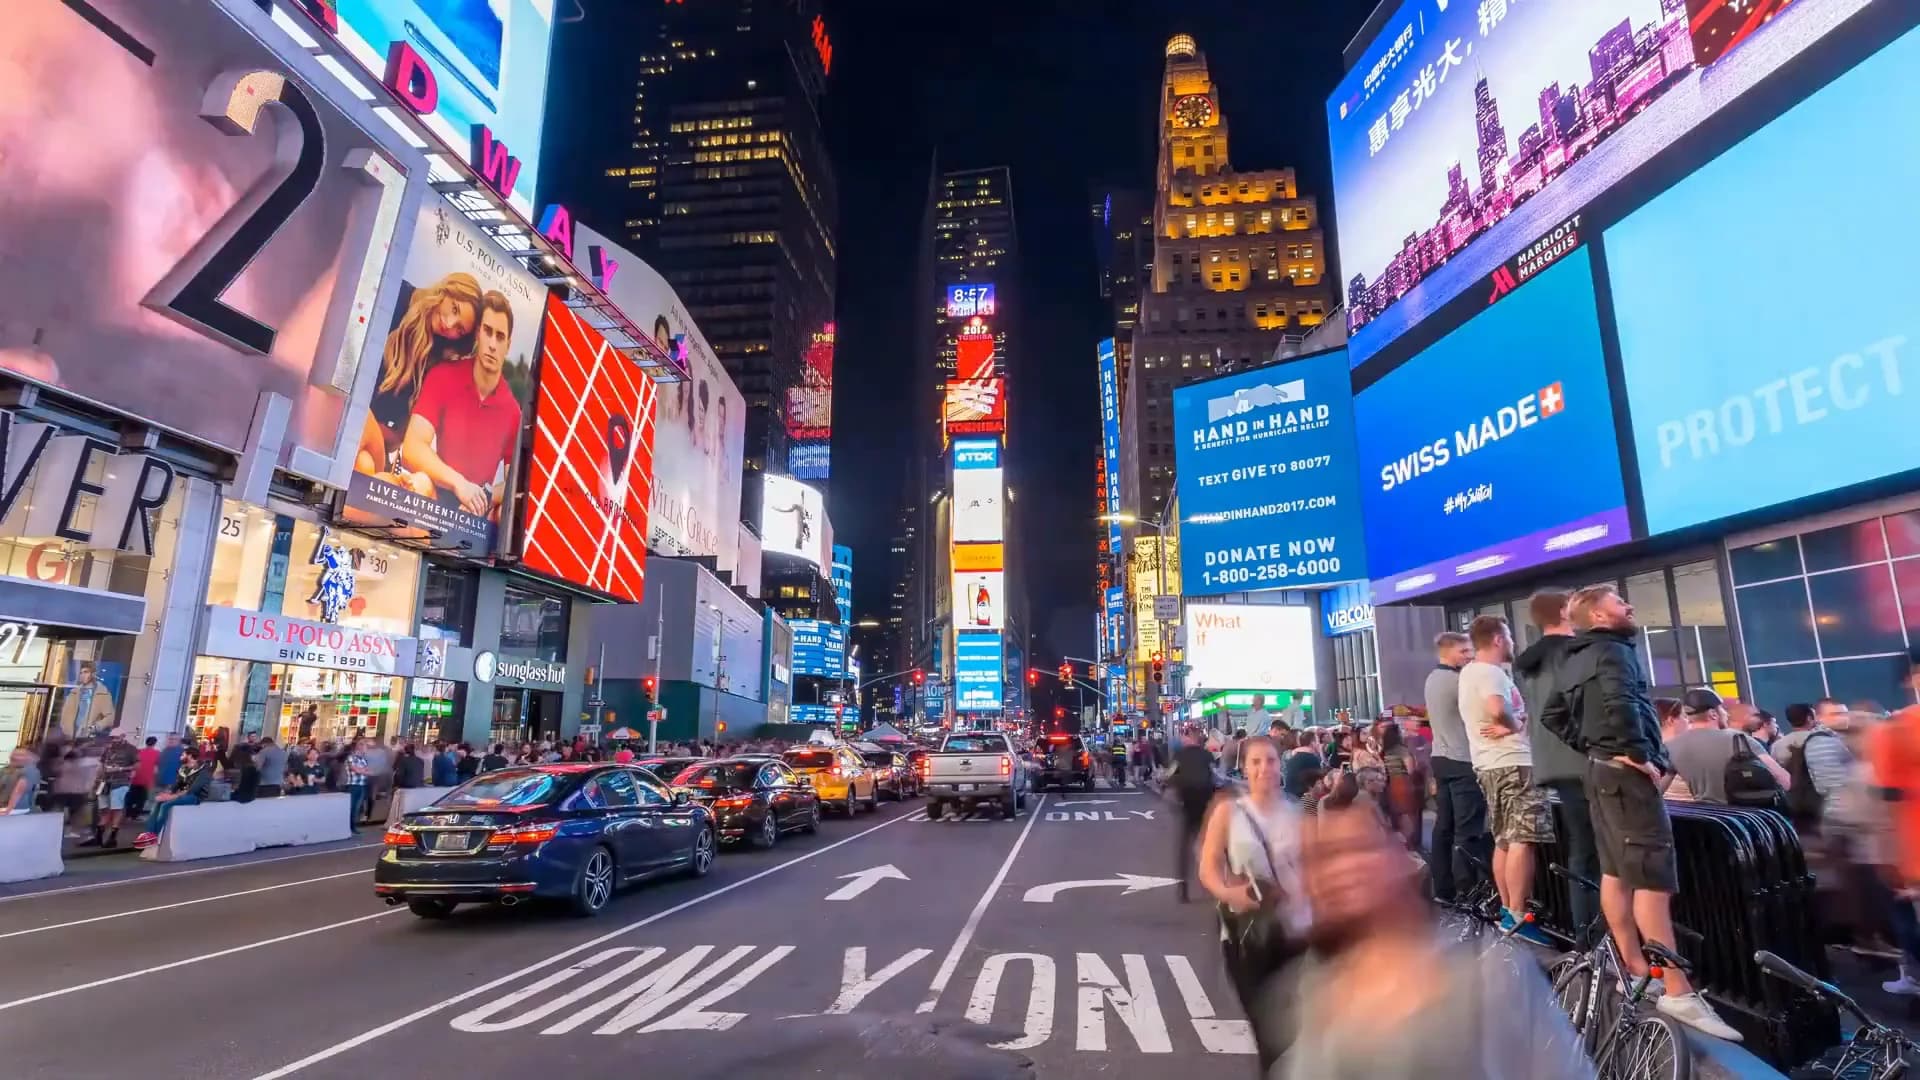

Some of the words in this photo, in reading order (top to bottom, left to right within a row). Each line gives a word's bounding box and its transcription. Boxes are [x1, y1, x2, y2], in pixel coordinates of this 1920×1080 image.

[1518, 214, 1581, 266] MARRIOTT
[456, 231, 476, 256] U.S.
[477, 247, 505, 279] POLO
[507, 273, 532, 303] ASSN.
[1520, 235, 1575, 279] MARQUIS
[953, 287, 989, 303] 8:57
[957, 333, 993, 341] TOSHIBA
[962, 325, 989, 335] 2017
[1656, 333, 1908, 470] PROTECT
[1193, 420, 1248, 444] HAND
[1252, 419, 1265, 431] IN
[1268, 404, 1329, 429] HAND
[1201, 438, 1234, 450] BENEFIT
[1235, 435, 1250, 443] FOR
[1252, 426, 1298, 441] HURRICANE
[1300, 420, 1330, 431] RELIEF
[965, 451, 994, 461] TDK
[1381, 438, 1450, 492] SWISS
[1454, 393, 1539, 457] MADE
[1198, 472, 1229, 487] TEXT
[1231, 464, 1267, 481] GIVE
[1270, 463, 1286, 475] TO
[1290, 455, 1331, 472] 80077
[366, 493, 389, 507] PAMELA
[369, 481, 399, 501] LIVE
[404, 495, 488, 532] AUTHENTICALLY
[1204, 543, 1281, 567] DONATE
[1288, 536, 1336, 557] NOW
[1202, 557, 1341, 586] 1-800-258-6000
[1194, 611, 1242, 630] What
[238, 614, 280, 642] U.S.
[285, 621, 344, 650] POLO
[347, 633, 400, 658] ASSN.
[1196, 631, 1209, 646] if
[279, 648, 326, 663] SINCE
[333, 650, 366, 667] 1890
[498, 660, 547, 685] sunglass
[548, 660, 566, 684] hut
[1044, 810, 1155, 821] ONLY
